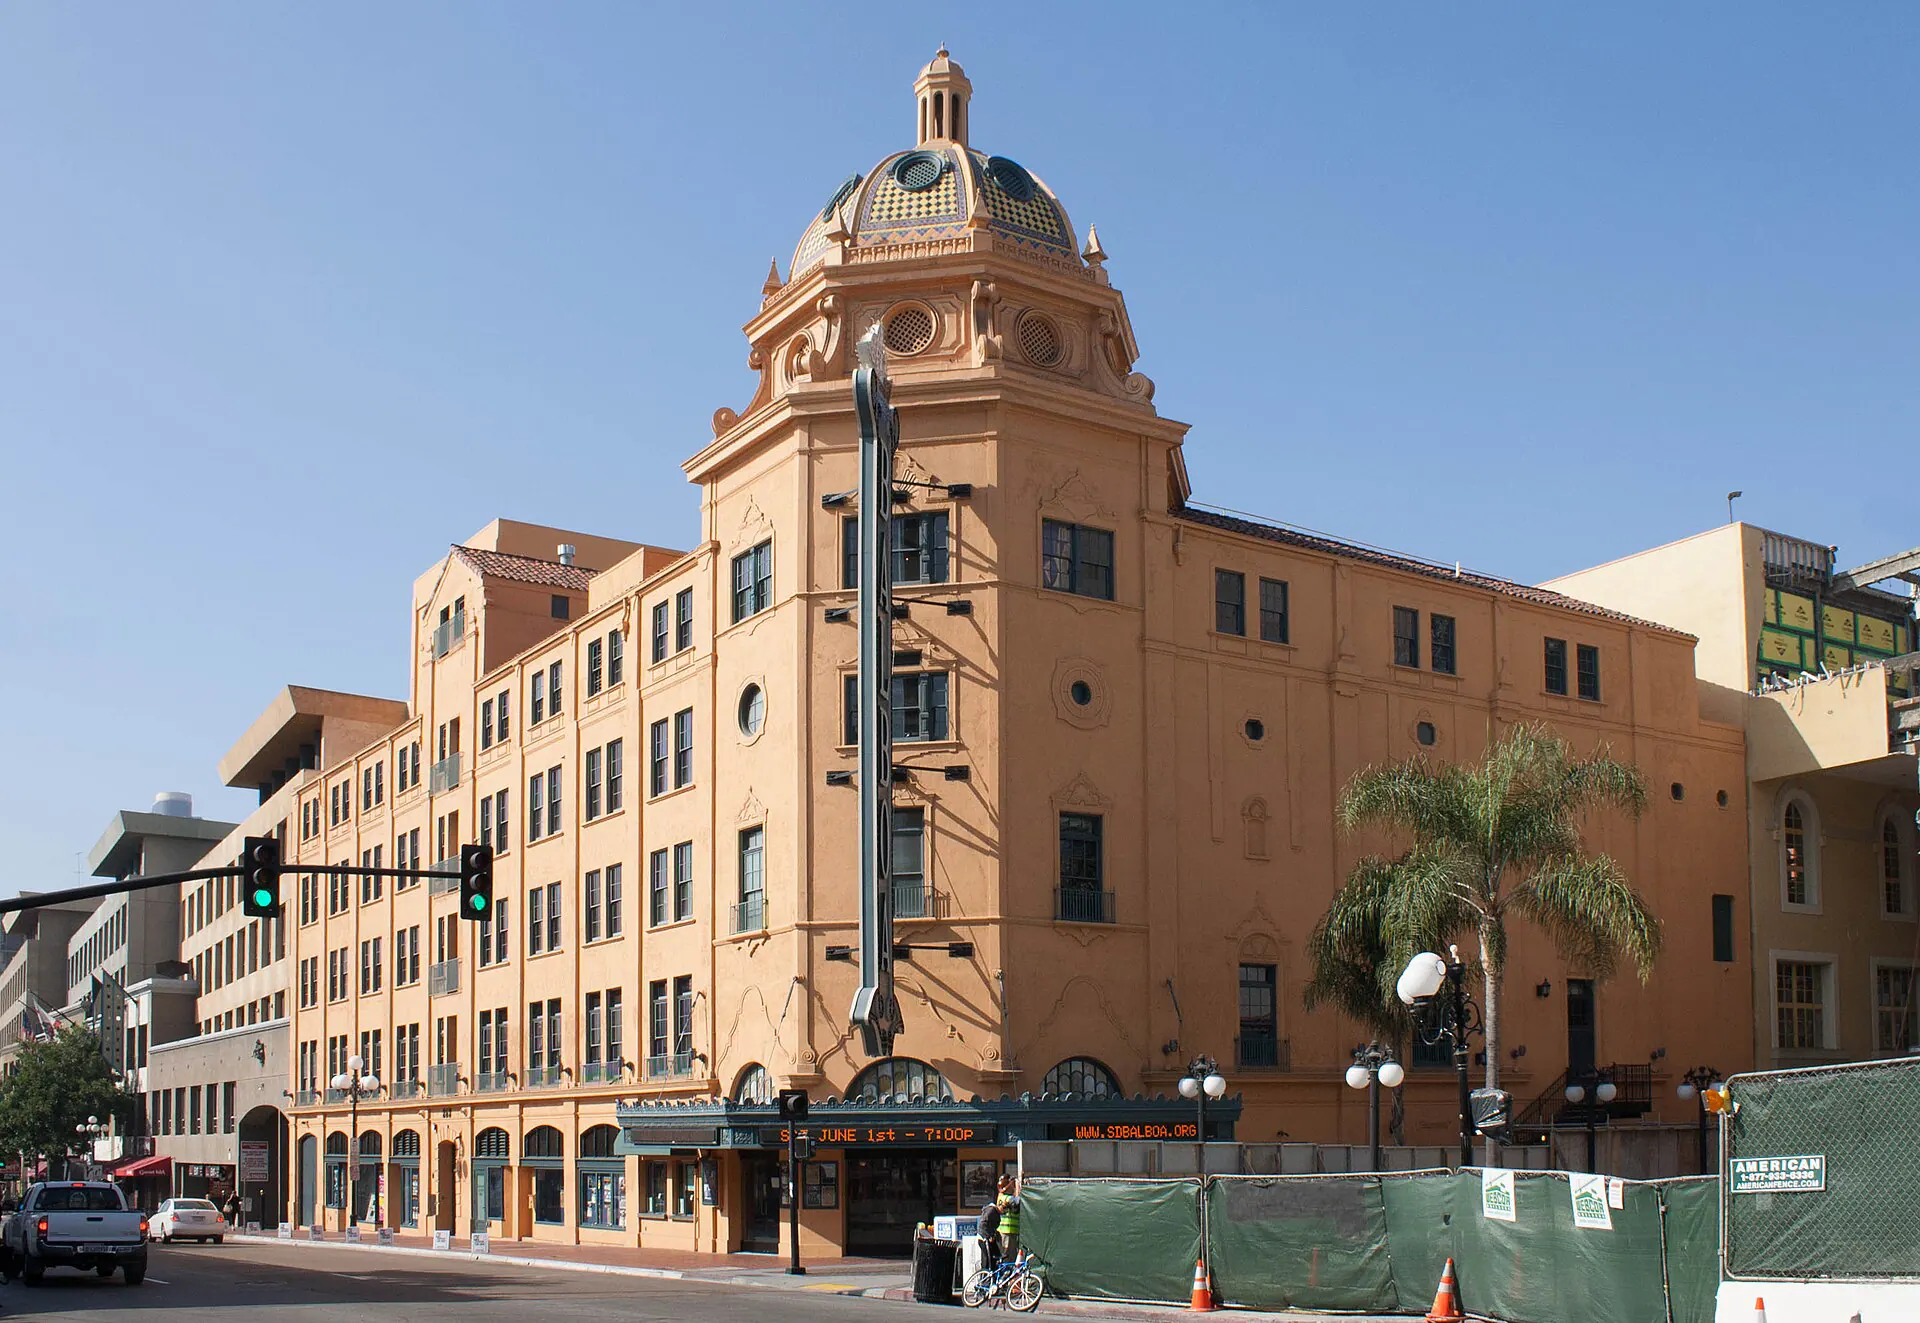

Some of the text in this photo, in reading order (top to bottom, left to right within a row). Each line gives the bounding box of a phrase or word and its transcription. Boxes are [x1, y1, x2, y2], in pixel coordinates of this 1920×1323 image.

[819, 1129, 857, 1142] JUNE
[868, 1129, 895, 1142] 1st
[1075, 1124, 1197, 1139] WWW.SDBALBOA.ORG
[1735, 1158, 1820, 1173] AMERICAN
[1736, 1180, 1819, 1190] AMERICANFENCE.COM
